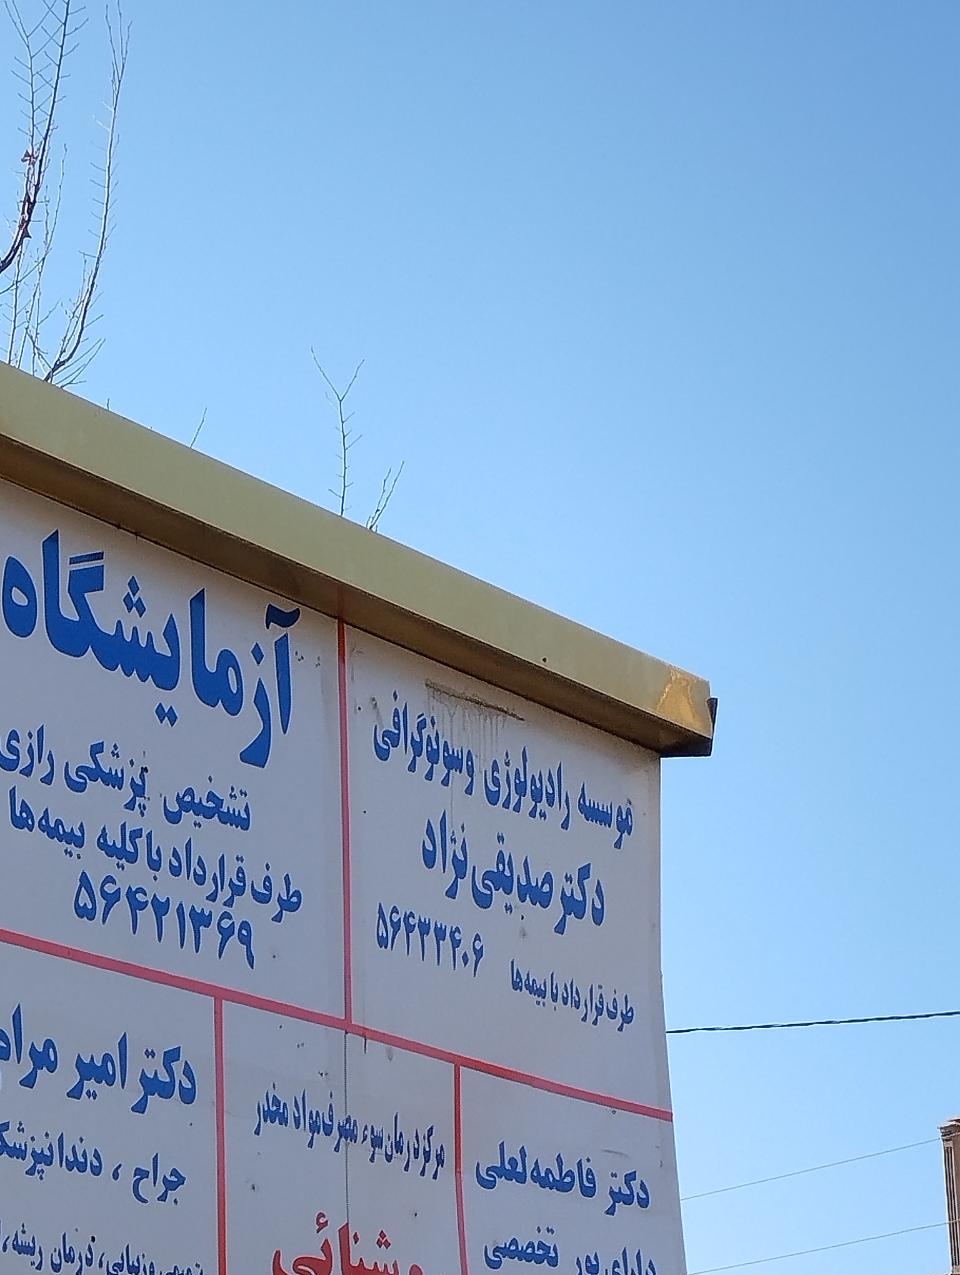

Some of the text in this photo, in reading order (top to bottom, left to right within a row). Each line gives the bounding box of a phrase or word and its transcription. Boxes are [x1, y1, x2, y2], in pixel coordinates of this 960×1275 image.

[2, 529, 302, 769] آزمایشگاه
[373, 690, 463, 787] سونوگرافی
[465, 749, 474, 796] و
[63, 741, 149, 817] پزشکی
[162, 775, 252, 831] تشخیص
[484, 746, 570, 831] رادیولوژی
[96, 821, 143, 870] کلیه
[146, 830, 162, 882] با
[169, 838, 248, 908] قرارداد
[421, 808, 605, 935] دکتر صدیقی نژاد
[74, 870, 254, 970] ۵۶۴۲۱۳۶۹
[250, 862, 302, 924] طرف
[376, 902, 484, 978] ۵۶۴۳۳۴۰۶
[551, 972, 558, 1011] با
[606, 990, 634, 1032] طرف
[66, 1031, 128, 1099] امیر
[129, 1045, 197, 1114] دکتر
[253, 1082, 445, 1180] مرکز درمان سوء مصرف مواد مخدر
[132, 1153, 187, 1206] جراح
[475, 1140, 650, 1216] دکتر فاطمه لعلی
[484, 1226, 559, 1270] تخصصی
